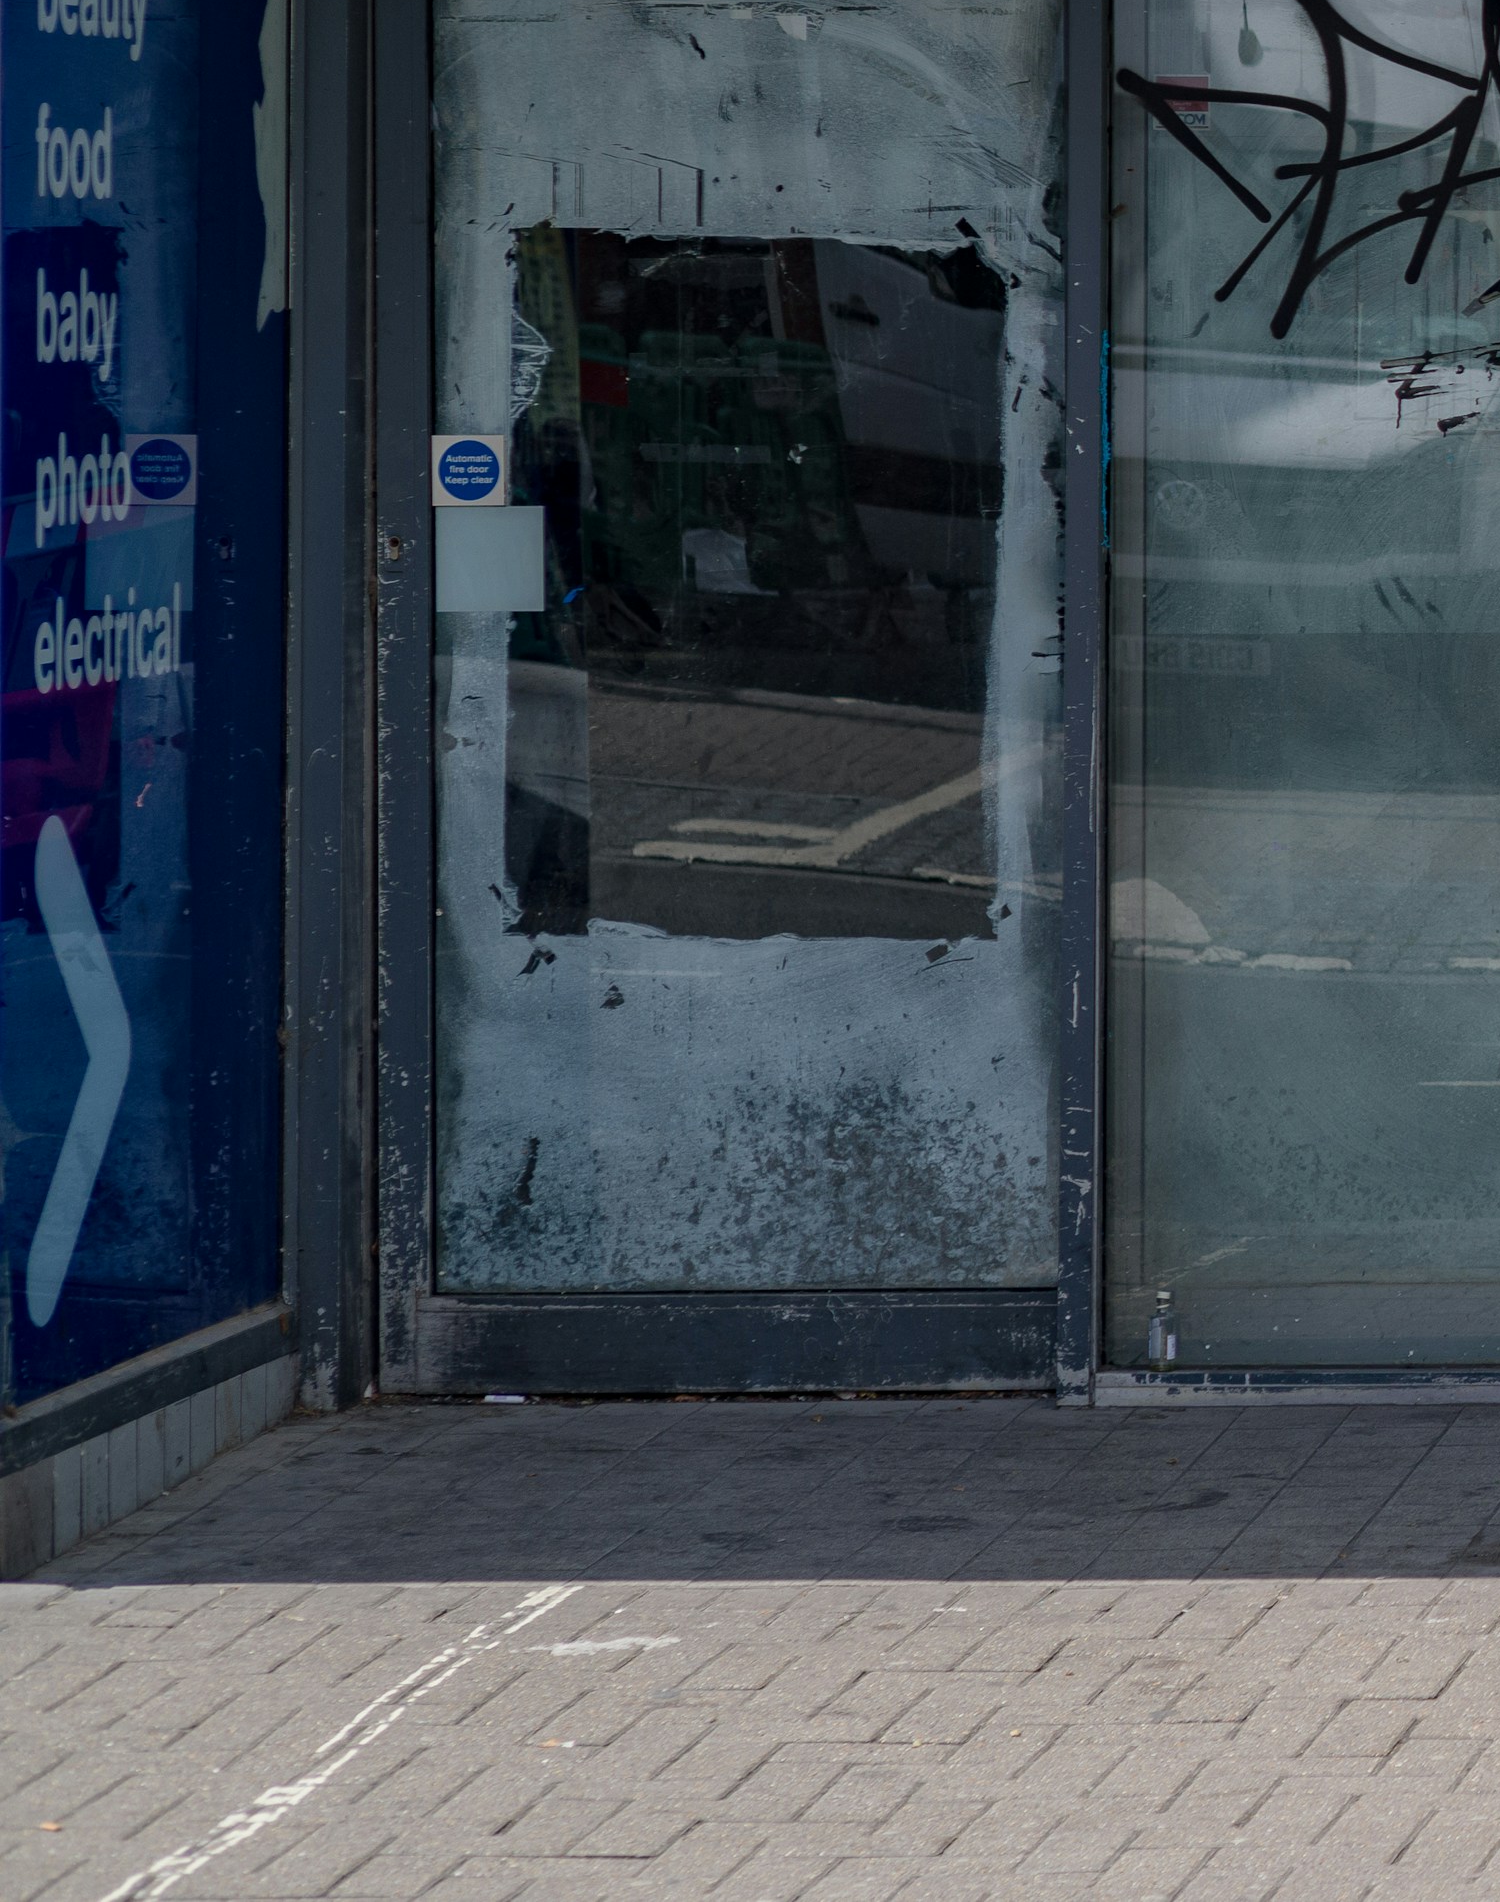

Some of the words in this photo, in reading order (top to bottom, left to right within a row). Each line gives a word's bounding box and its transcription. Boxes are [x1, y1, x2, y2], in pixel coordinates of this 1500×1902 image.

[36, 102, 114, 201] food
[36, 268, 119, 381] baby
[34, 431, 131, 549] photo
[445, 476, 469, 485] Keep
[470, 476, 494, 484] clear
[446, 455, 493, 463] Automatic
[449, 465, 465, 473] fire
[466, 465, 489, 473] door
[34, 582, 183, 695] electrical
